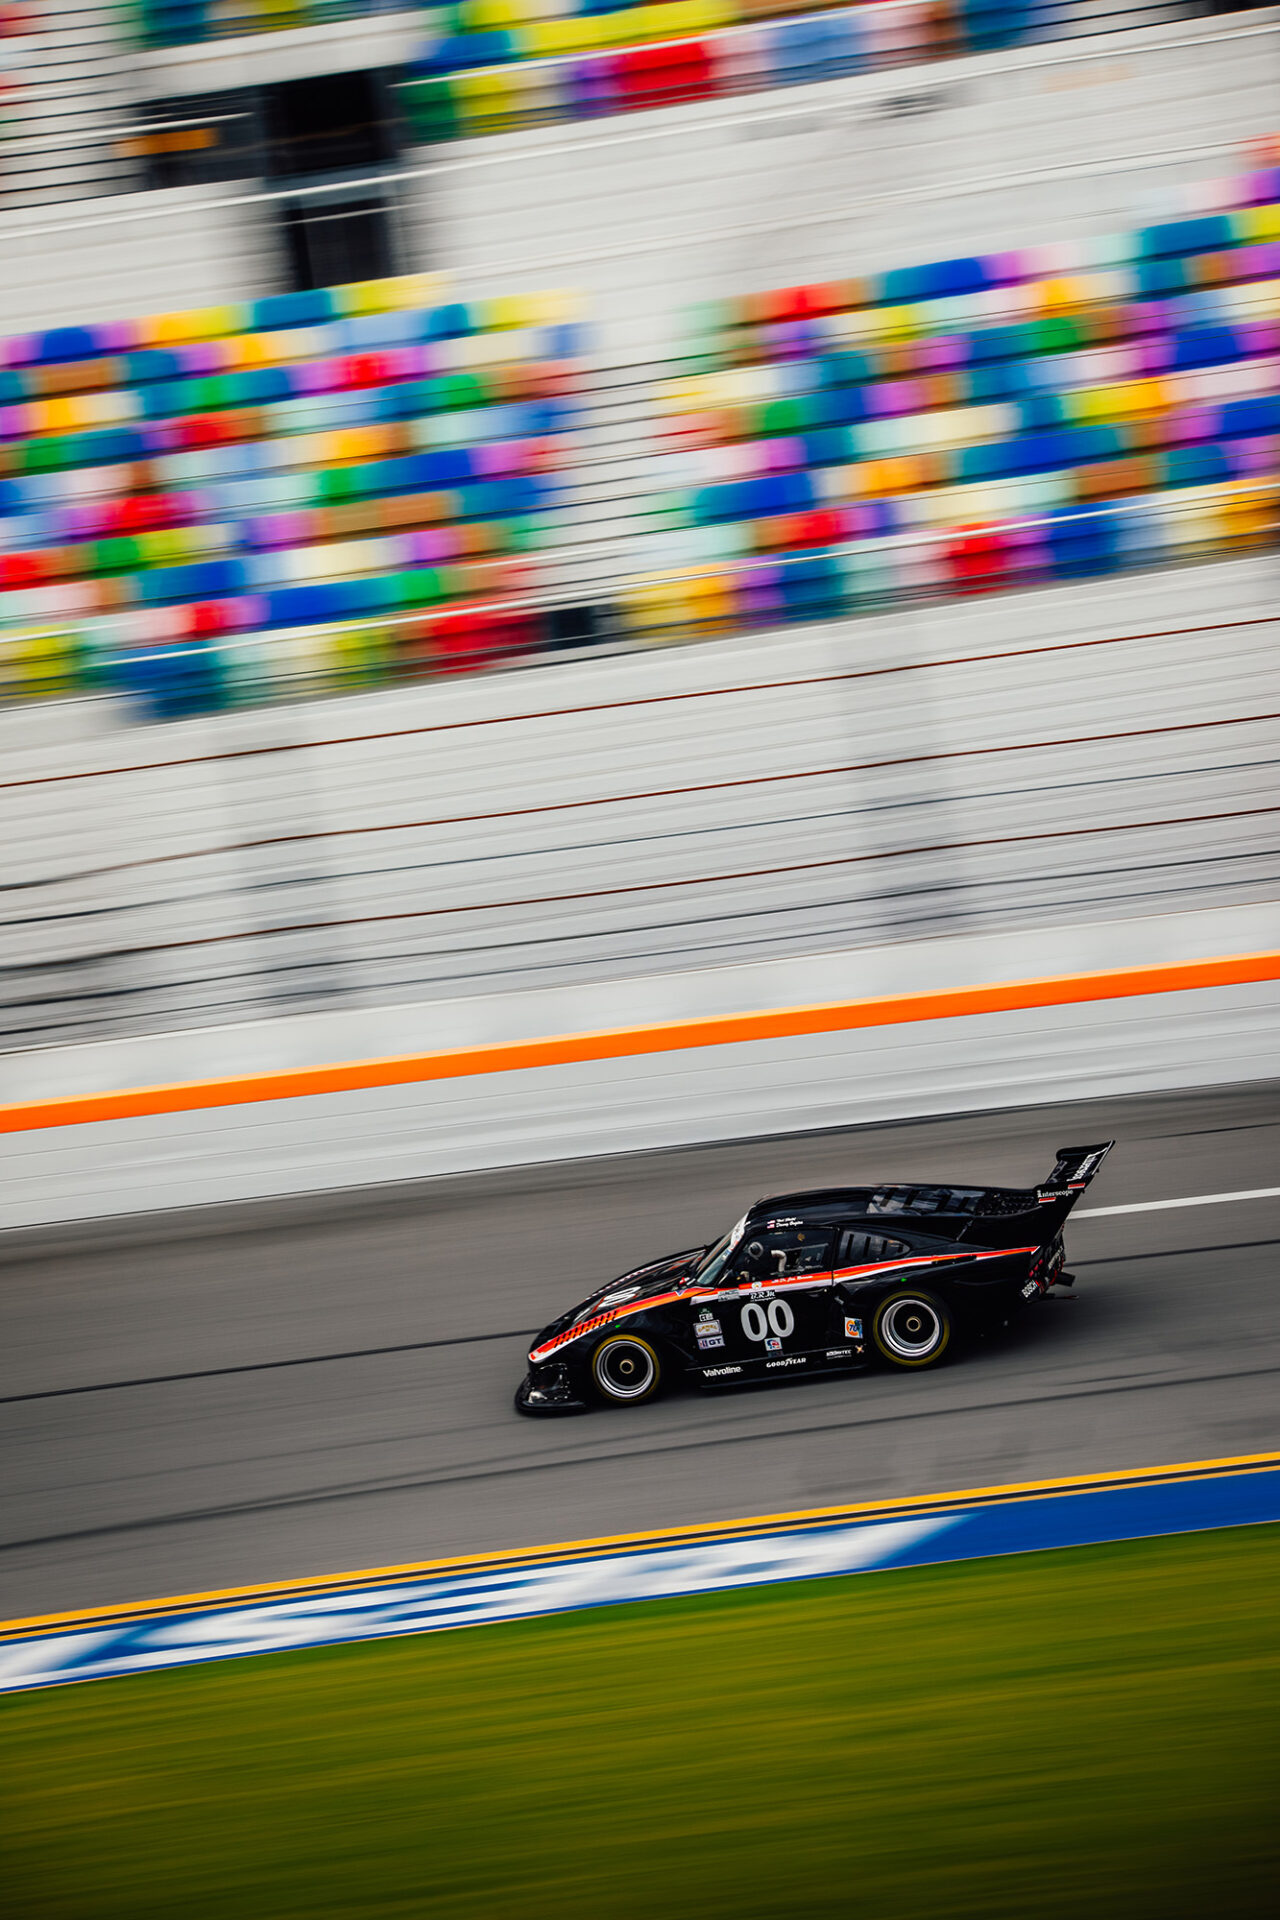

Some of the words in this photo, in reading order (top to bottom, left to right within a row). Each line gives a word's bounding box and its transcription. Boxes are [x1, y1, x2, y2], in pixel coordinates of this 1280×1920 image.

[1037, 1189, 1074, 1198] Interscope
[1022, 1280, 1038, 1298] BOSCH
[741, 1299, 794, 1342] 00
[708, 1338, 722, 1346] GT
[766, 1358, 807, 1368] GOODYEAR
[703, 1366, 742, 1378] Valvoline
